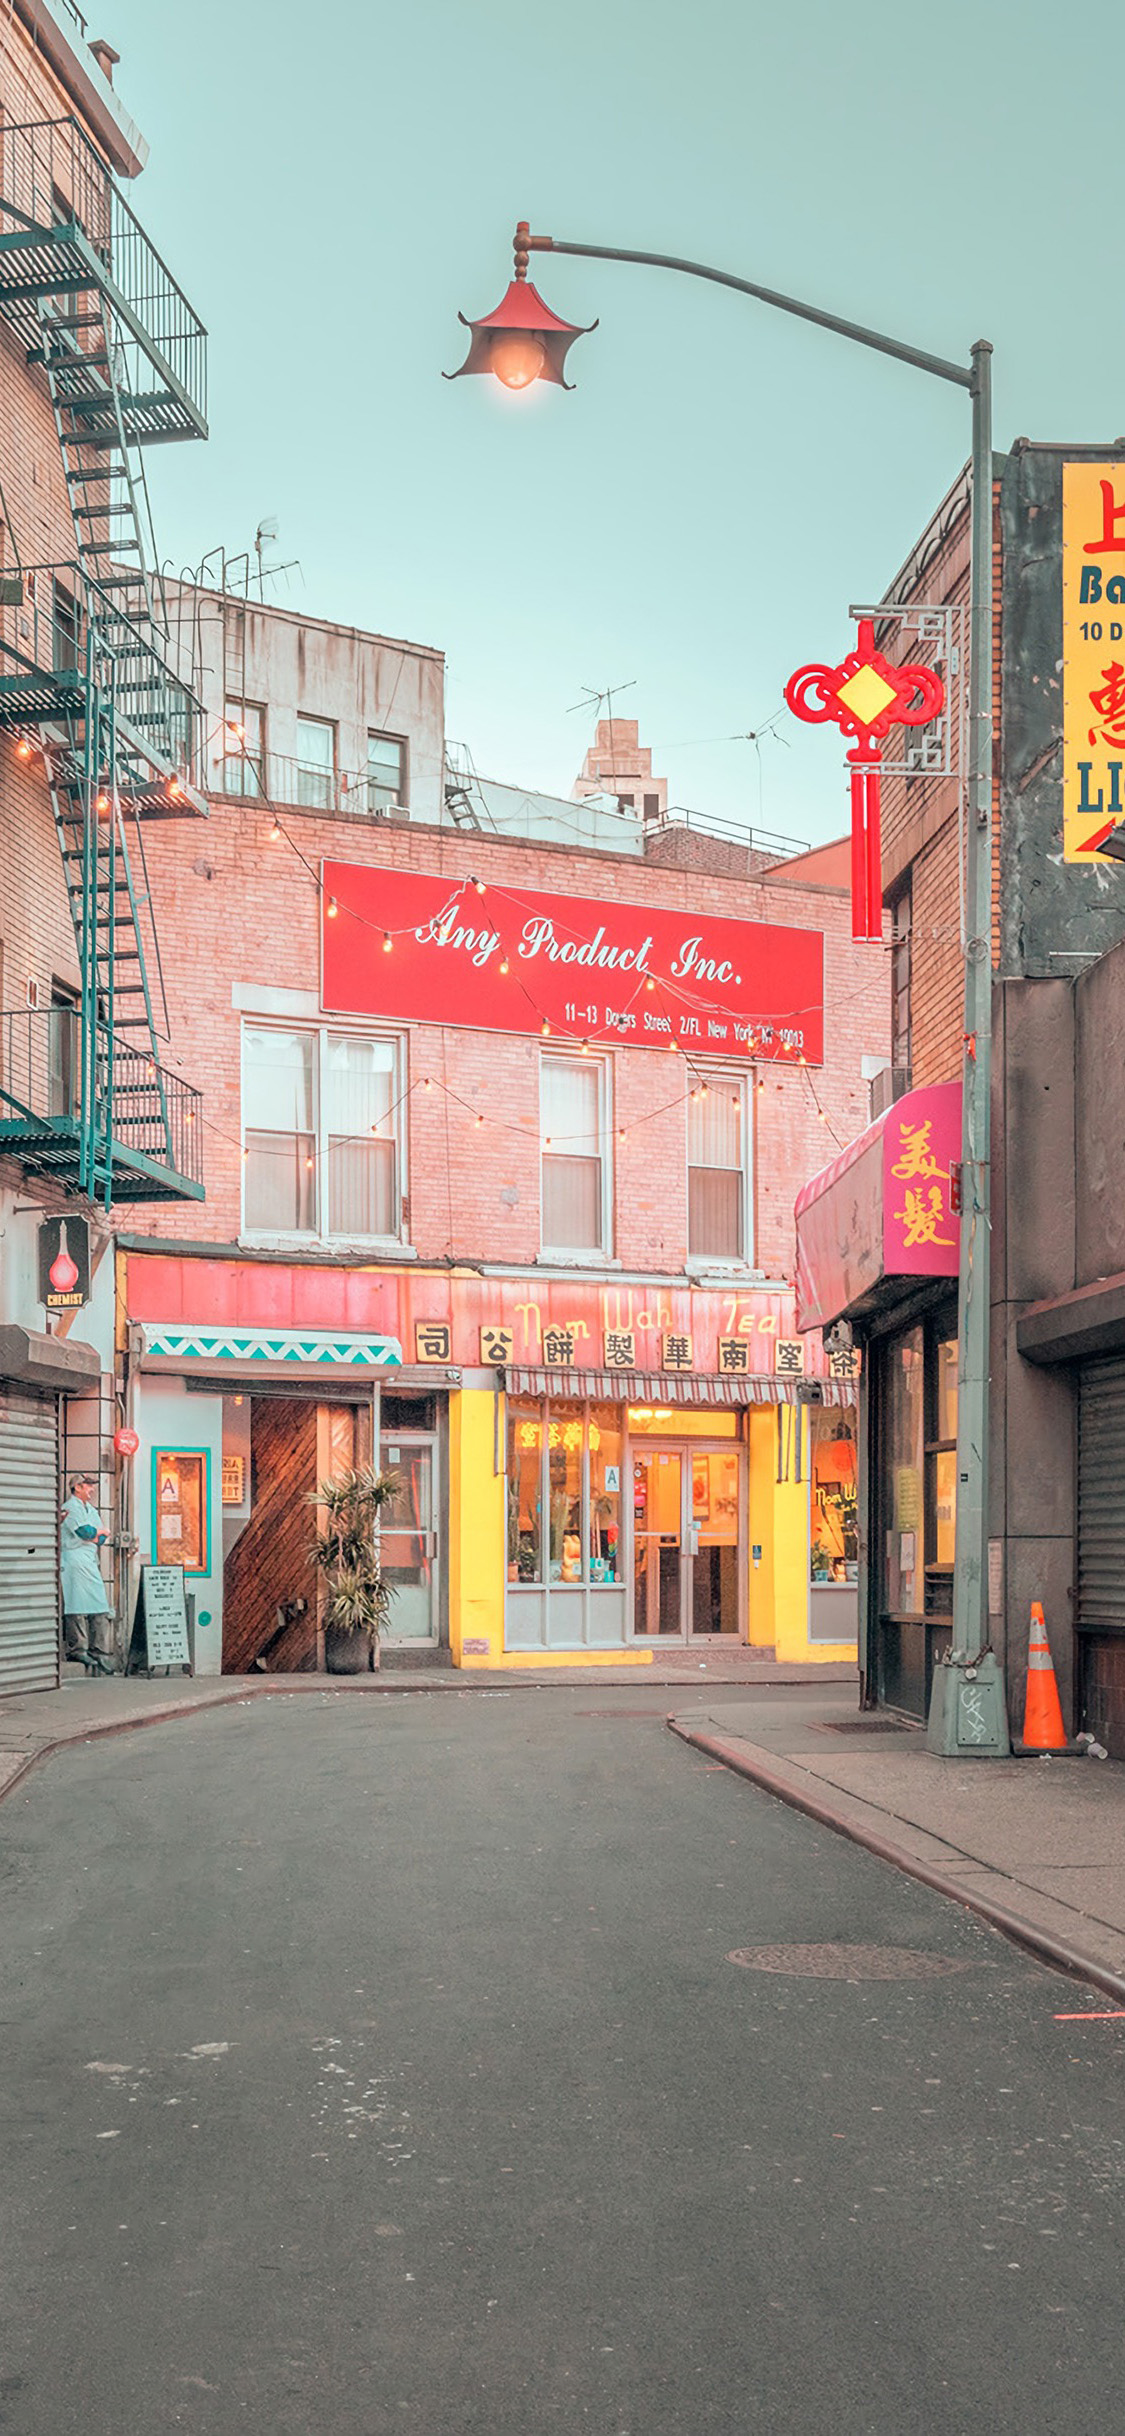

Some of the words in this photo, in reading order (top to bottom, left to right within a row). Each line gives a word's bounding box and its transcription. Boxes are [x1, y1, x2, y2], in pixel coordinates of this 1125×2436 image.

[1079, 622, 1102, 641] 10
[1110, 622, 1123, 641] D
[1077, 761, 1125, 813] LI
[415, 904, 500, 967] Any
[518, 917, 653, 973] Product
[671, 937, 741, 984] Inc.
[565, 1002, 597, 1025] 11-13
[643, 1011, 672, 1033] Street
[680, 1015, 701, 1037] 2/FL
[708, 1019, 727, 1038] New
[891, 1120, 956, 1247] 美髮
[47, 1292, 84, 1306] CHEMIST
[514, 1302, 590, 1347] Nm
[604, 1289, 673, 1332] Wah
[161, 1477, 175, 1494] A
[607, 1469, 617, 1484] A
